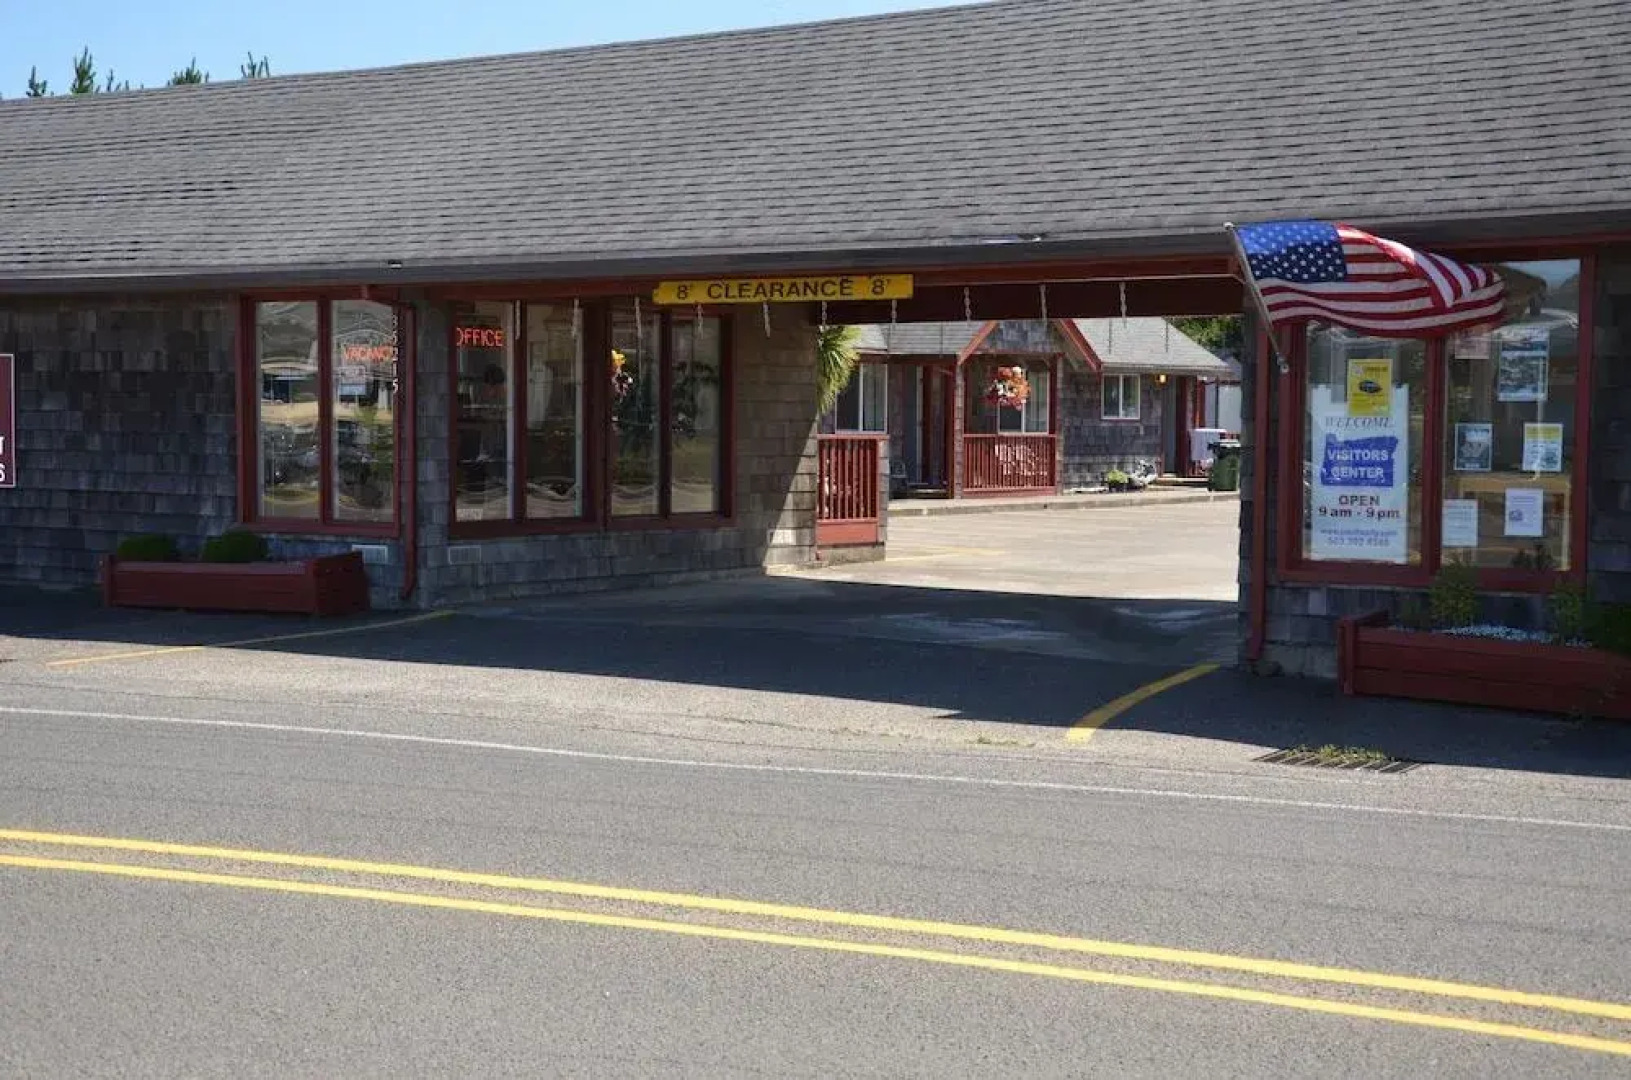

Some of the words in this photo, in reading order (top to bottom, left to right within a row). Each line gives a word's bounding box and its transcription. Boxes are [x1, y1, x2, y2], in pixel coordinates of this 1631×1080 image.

[706, 277, 854, 299] CLEARANCE
[871, 278, 890, 297] 8'
[1326, 416, 1394, 429] WELCOME
[1327, 449, 1389, 461] VISITORS
[1331, 467, 1384, 479] CENTER
[1338, 495, 1381, 507] OPEN
[1318, 507, 1327, 518] 9
[1330, 508, 1352, 518] am
[1366, 507, 1375, 518] 9
[1377, 509, 1400, 522] pm
